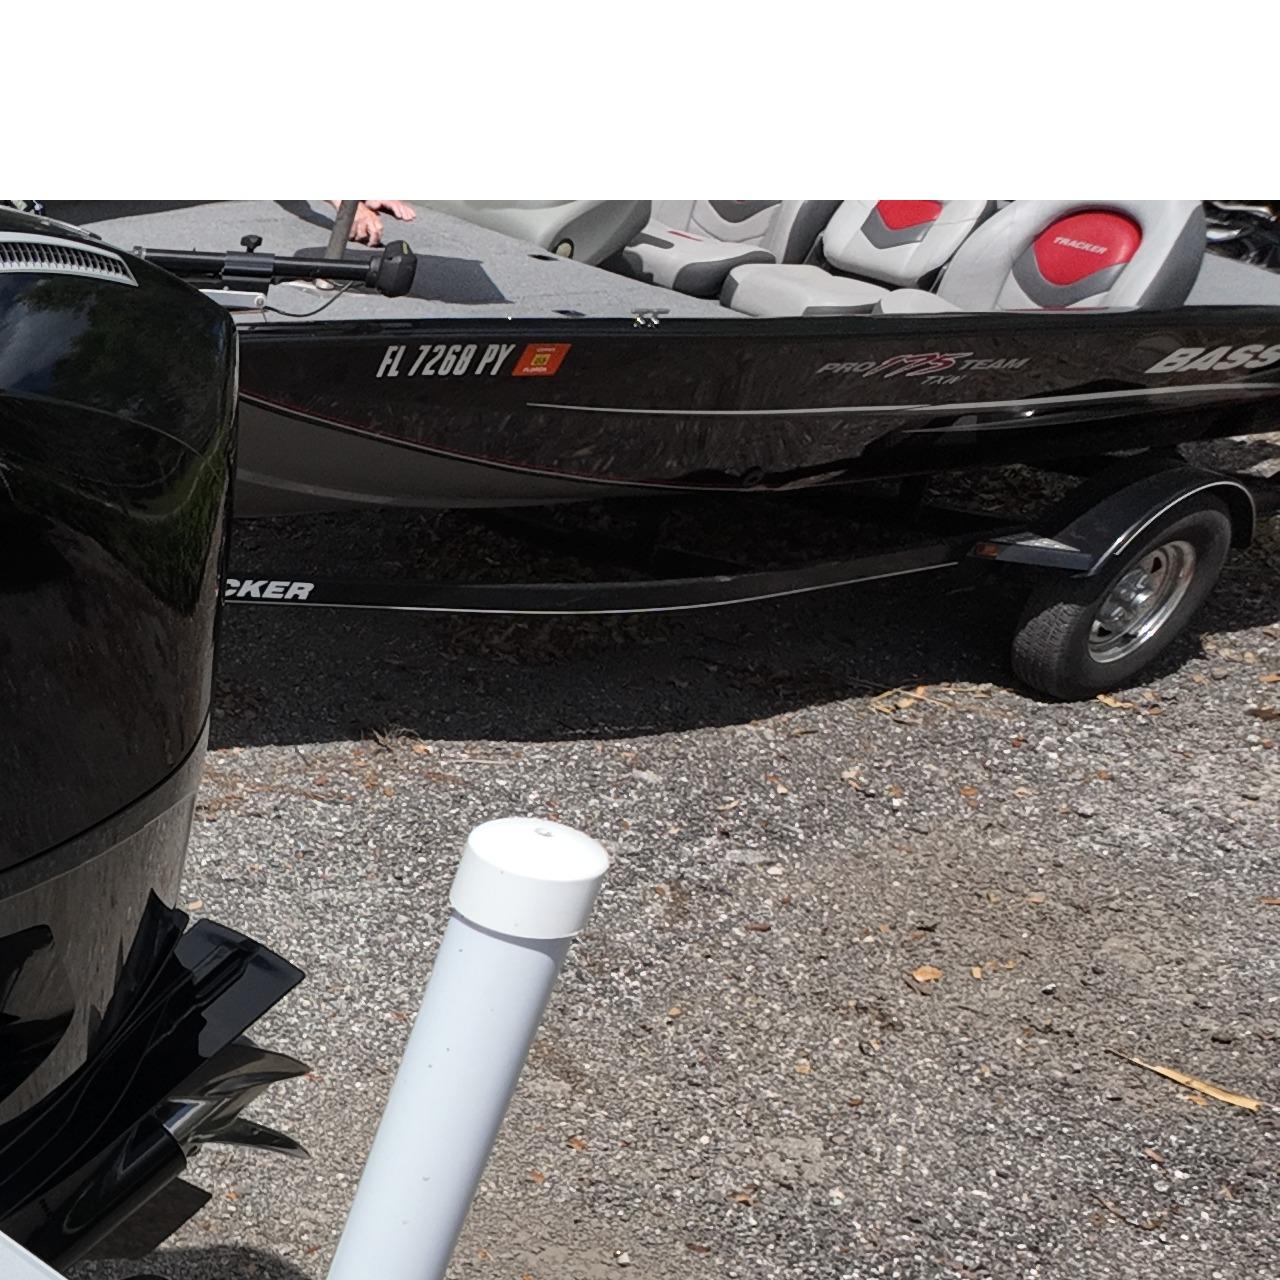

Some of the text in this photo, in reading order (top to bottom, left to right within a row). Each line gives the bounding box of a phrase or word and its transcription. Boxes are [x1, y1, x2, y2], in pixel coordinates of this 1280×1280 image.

[1052, 236, 1108, 255] TRACKER
[376, 345, 407, 378] FL
[474, 343, 517, 376] PY
[816, 361, 876, 374] PRO
[958, 357, 1031, 371] TEAM
[1144, 344, 1280, 374] BASS
